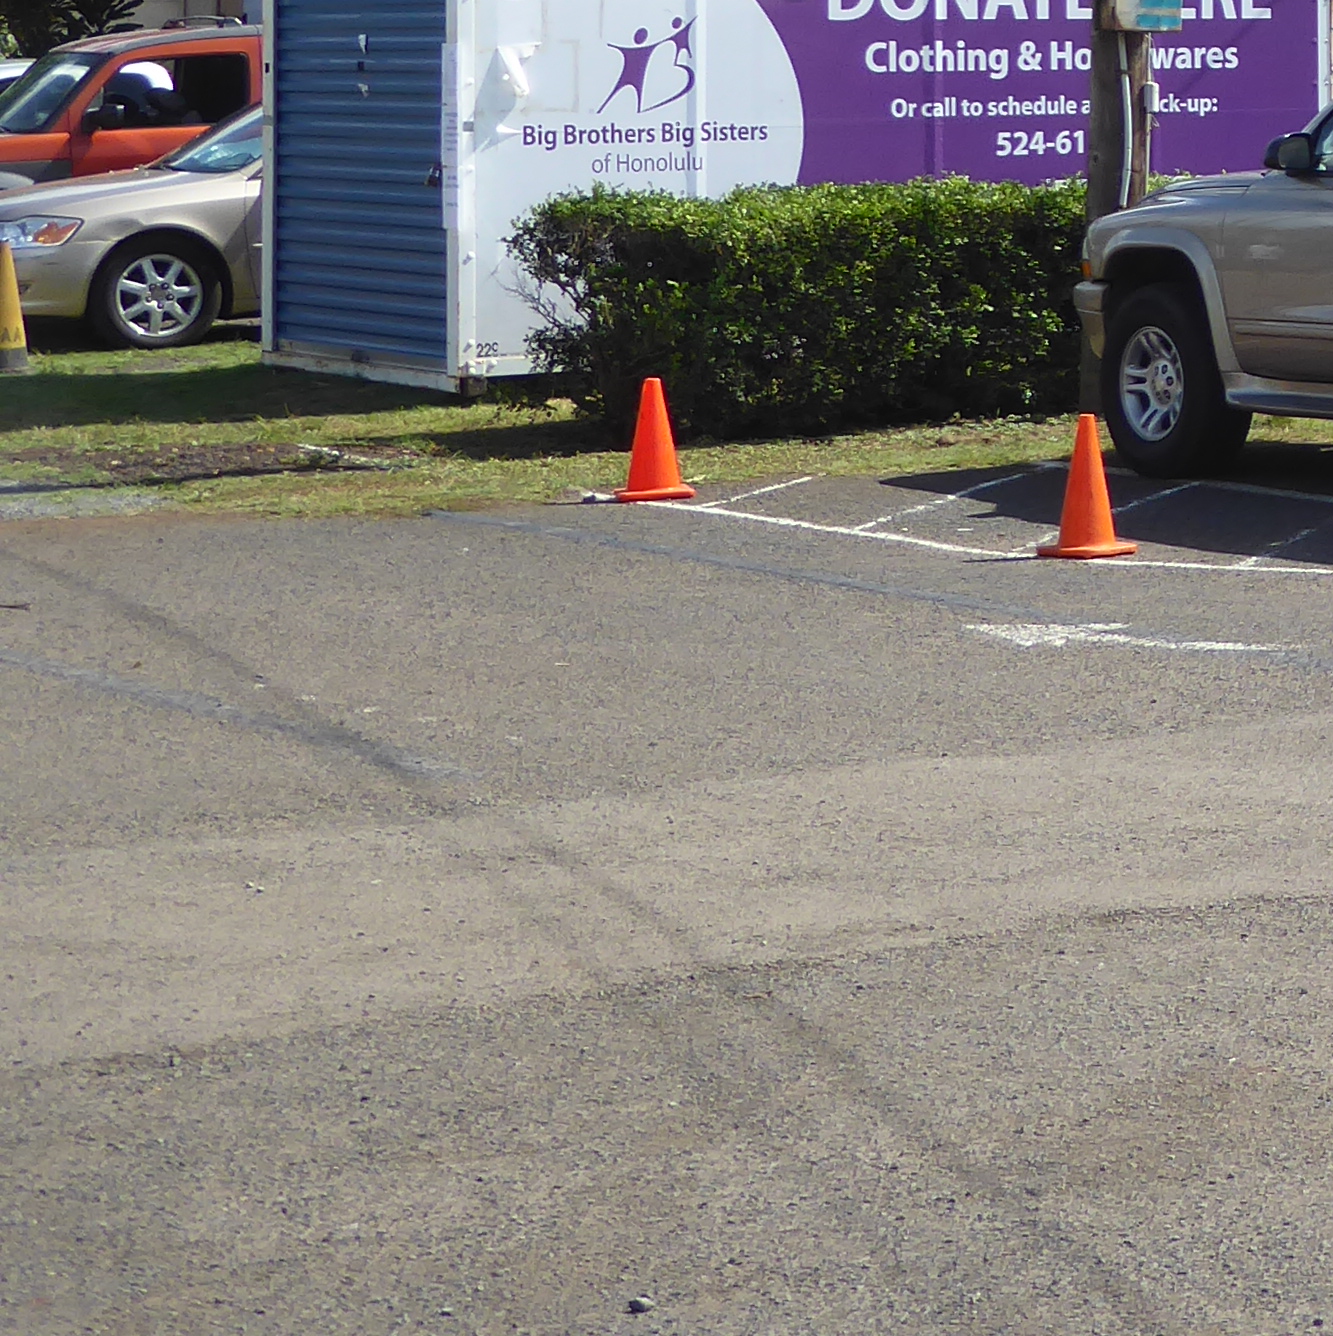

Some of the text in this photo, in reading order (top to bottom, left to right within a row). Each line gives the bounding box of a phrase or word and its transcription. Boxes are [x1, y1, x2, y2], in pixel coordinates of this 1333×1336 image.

[864, 39, 1240, 80] Clothing & Howares
[891, 98, 918, 118] Or
[921, 97, 957, 118] call
[960, 98, 982, 117] to
[987, 95, 1079, 117] schedule
[522, 121, 768, 151] Big Brothers Big Sisters
[995, 129, 1087, 157] 524-61
[591, 151, 703, 174] of Honolulu
